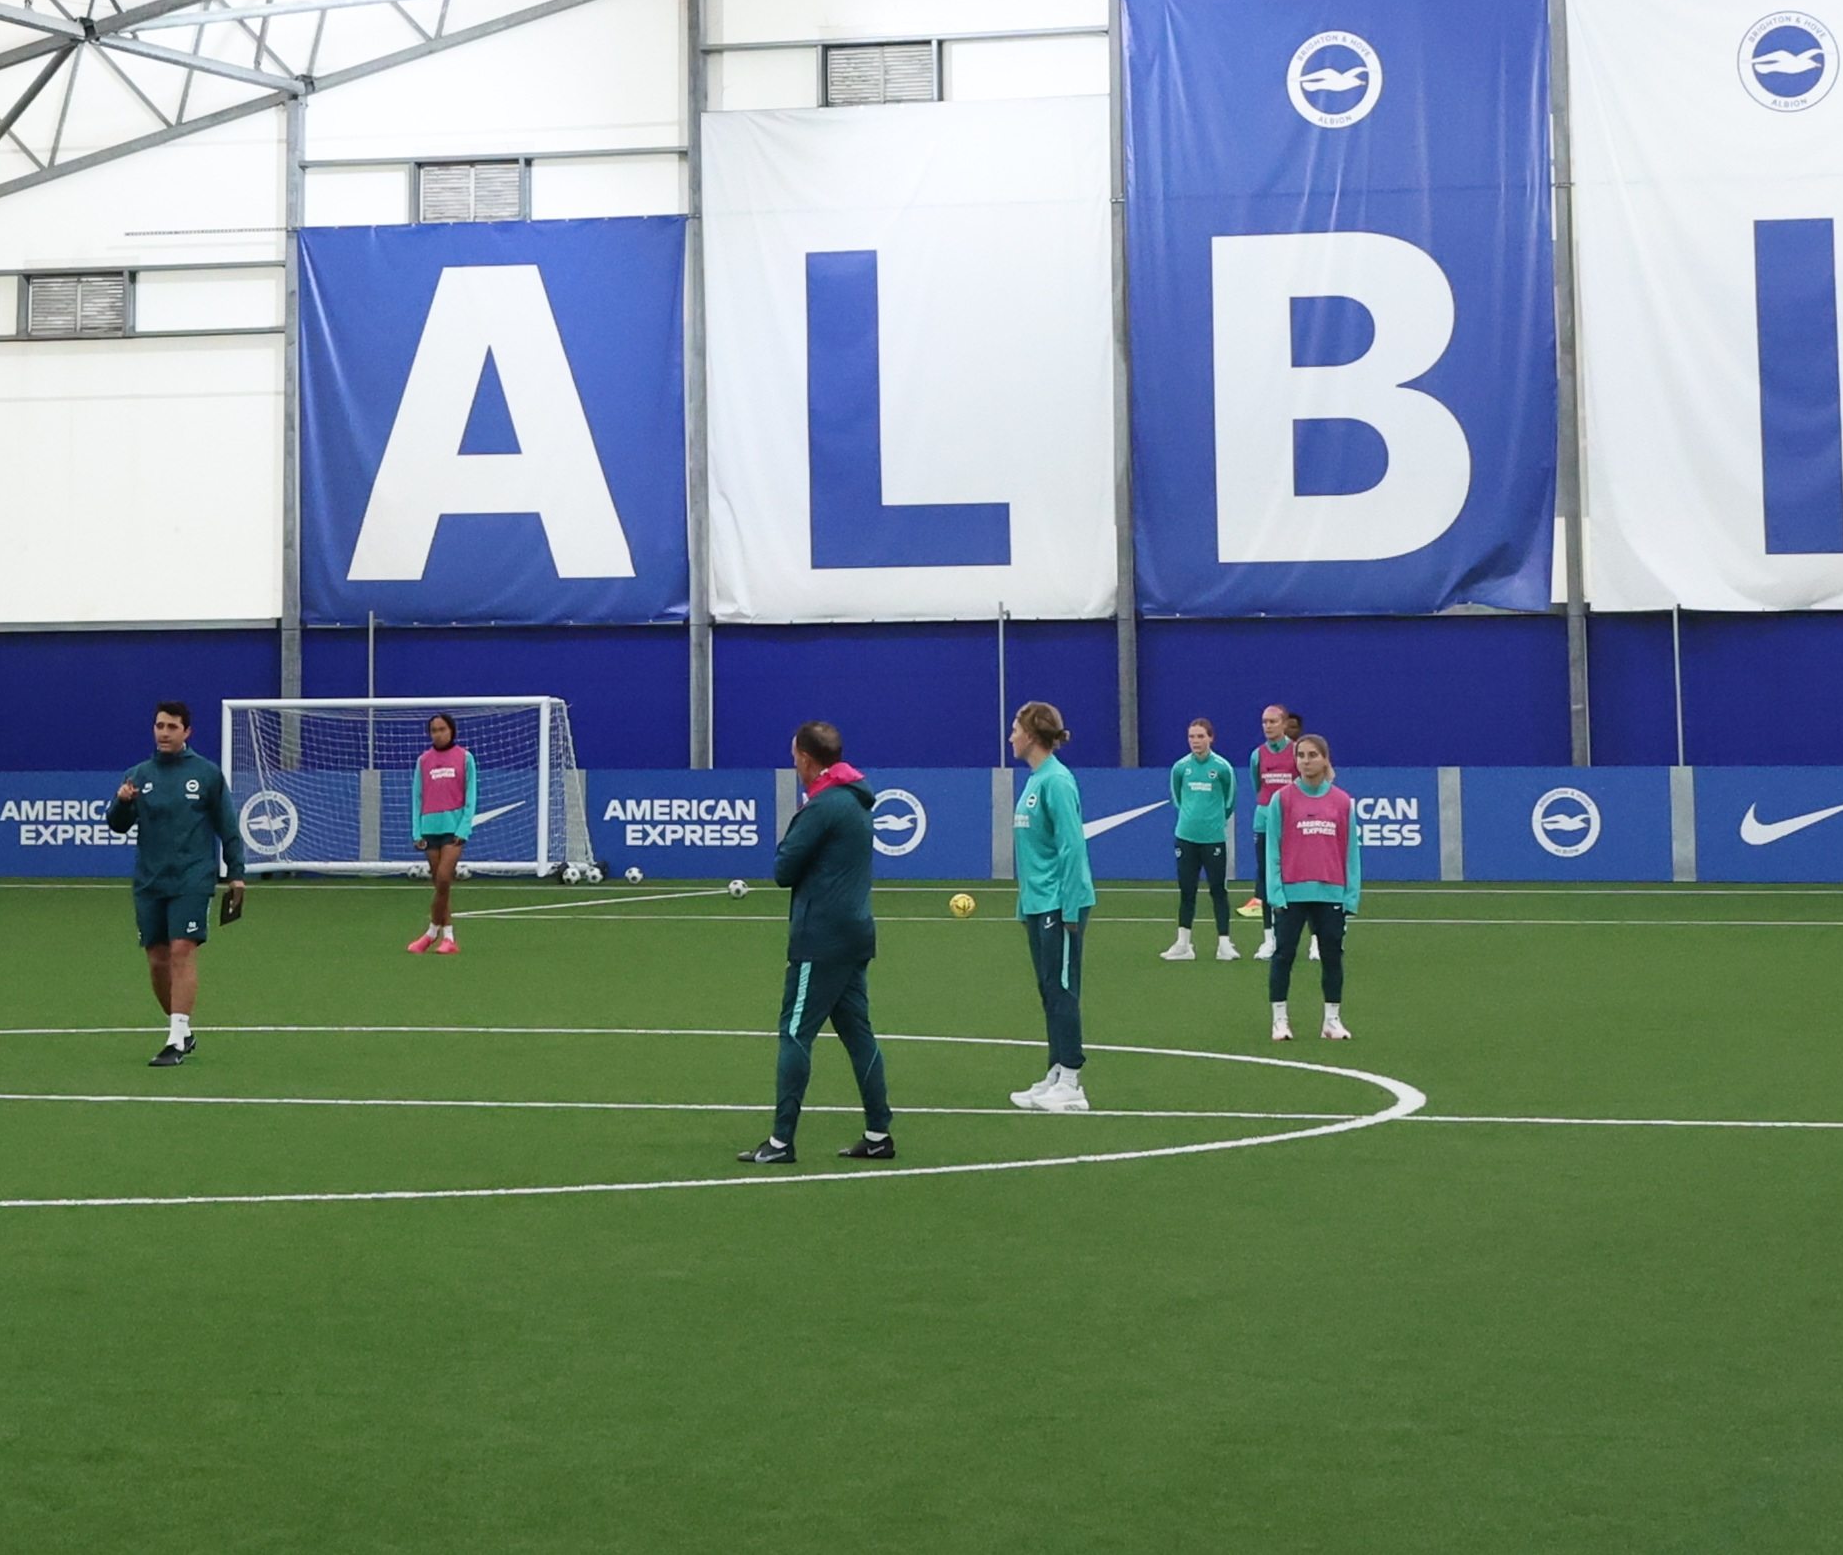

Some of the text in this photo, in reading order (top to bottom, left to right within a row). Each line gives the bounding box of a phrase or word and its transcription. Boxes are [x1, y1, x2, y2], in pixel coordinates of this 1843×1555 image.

[1748, 16, 1792, 43] BRIGHTON
[1803, 20, 1828, 40] HOVE
[1296, 35, 1339, 62] BRIGHTON
[1349, 39, 1372, 58] HOVE
[1770, 98, 1808, 109] ALBION
[1317, 115, 1353, 125] ALBION
[0, 800, 112, 821] AMERIC
[603, 799, 756, 821] AMERICAN
[625, 824, 758, 846] EXPRESS
